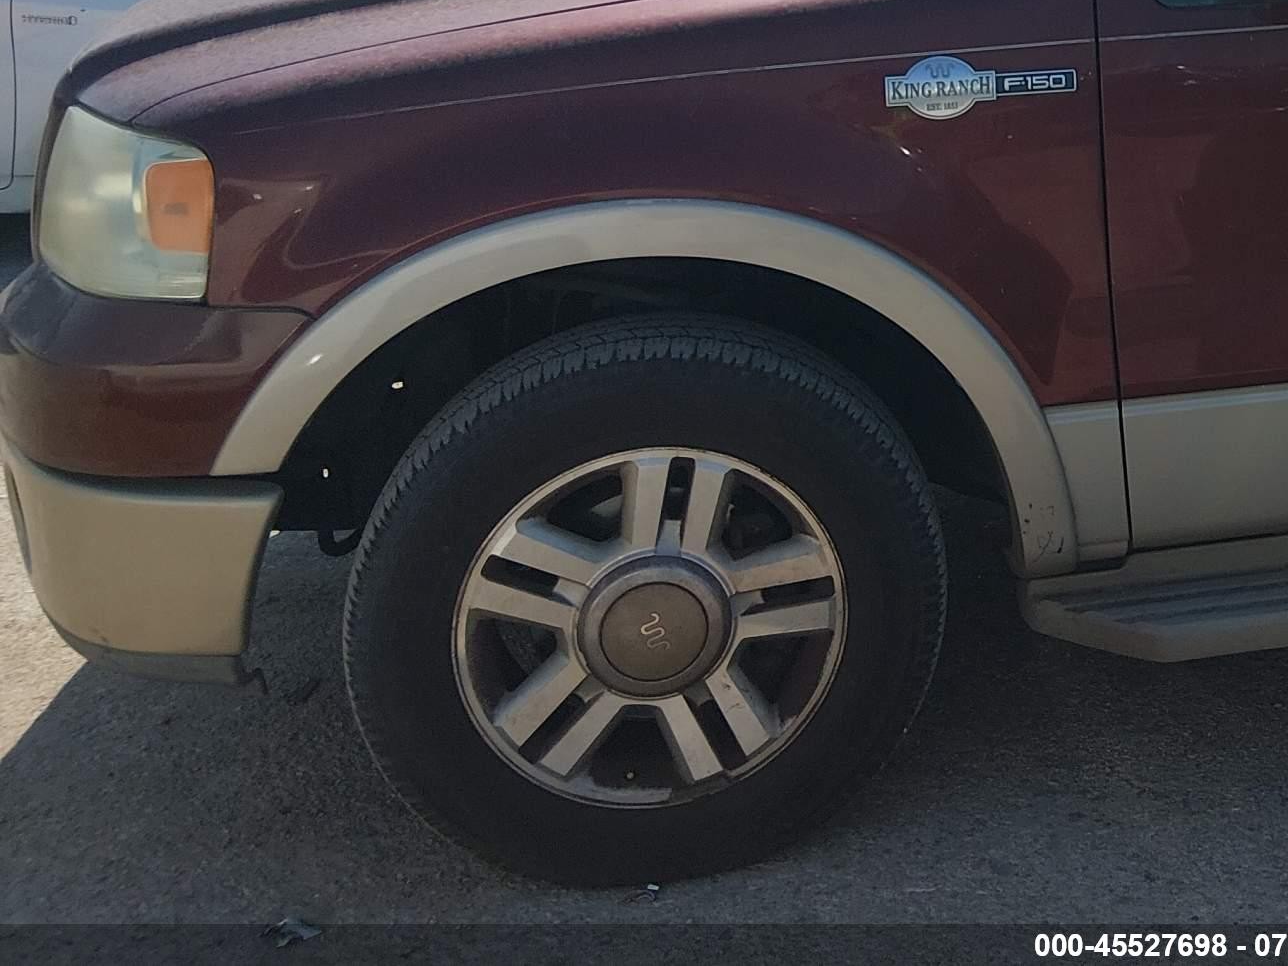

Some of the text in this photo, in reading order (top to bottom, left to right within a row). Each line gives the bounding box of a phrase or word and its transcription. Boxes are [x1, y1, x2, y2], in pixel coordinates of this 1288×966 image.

[891, 74, 1066, 100] KING RANCH F-150
